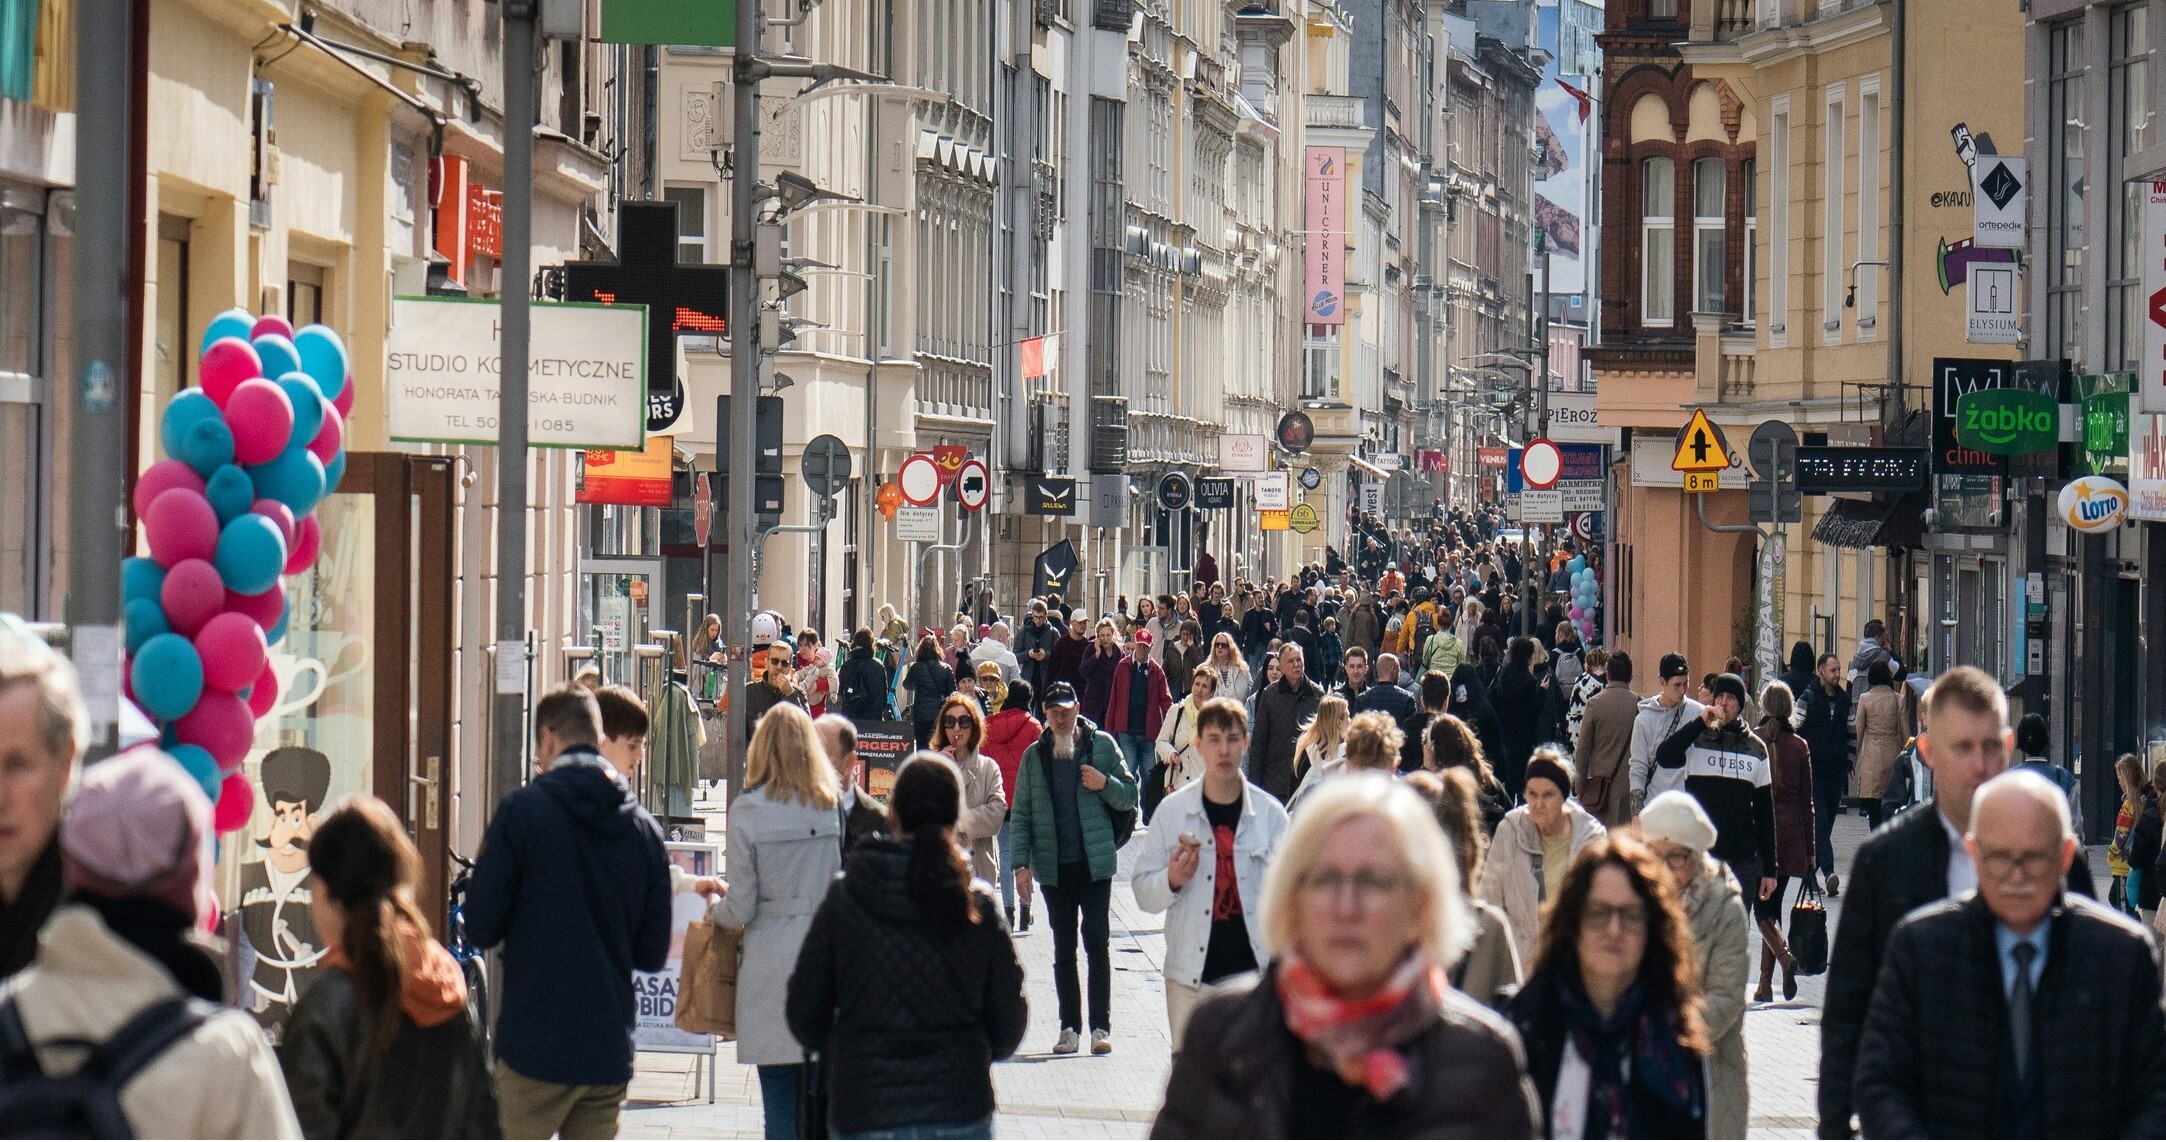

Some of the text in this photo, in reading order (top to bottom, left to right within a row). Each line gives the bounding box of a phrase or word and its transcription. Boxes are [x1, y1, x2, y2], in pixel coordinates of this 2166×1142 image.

[1321, 182, 1330, 285] UNICORNER
[1970, 319, 2016, 330] ELYSIUM
[389, 353, 634, 380] STUDIO KOMETYCZNE
[405, 387, 478, 400] HONORATA
[446, 415, 469, 428] TEL
[1965, 402, 2050, 432] żabka
[587, 453, 609, 462] HOME
[1200, 483, 1229, 496] OLIVIA
[1690, 476, 1714, 489] 8 m
[697, 500, 708, 520] STOP
[913, 510, 934, 518] dotyczy
[1296, 508, 1309, 518] 66
[2081, 496, 2118, 521] LOTTO
[1707, 755, 1753, 772] GUESS
[632, 976, 680, 997] ASA
[634, 996, 675, 1017] BID
